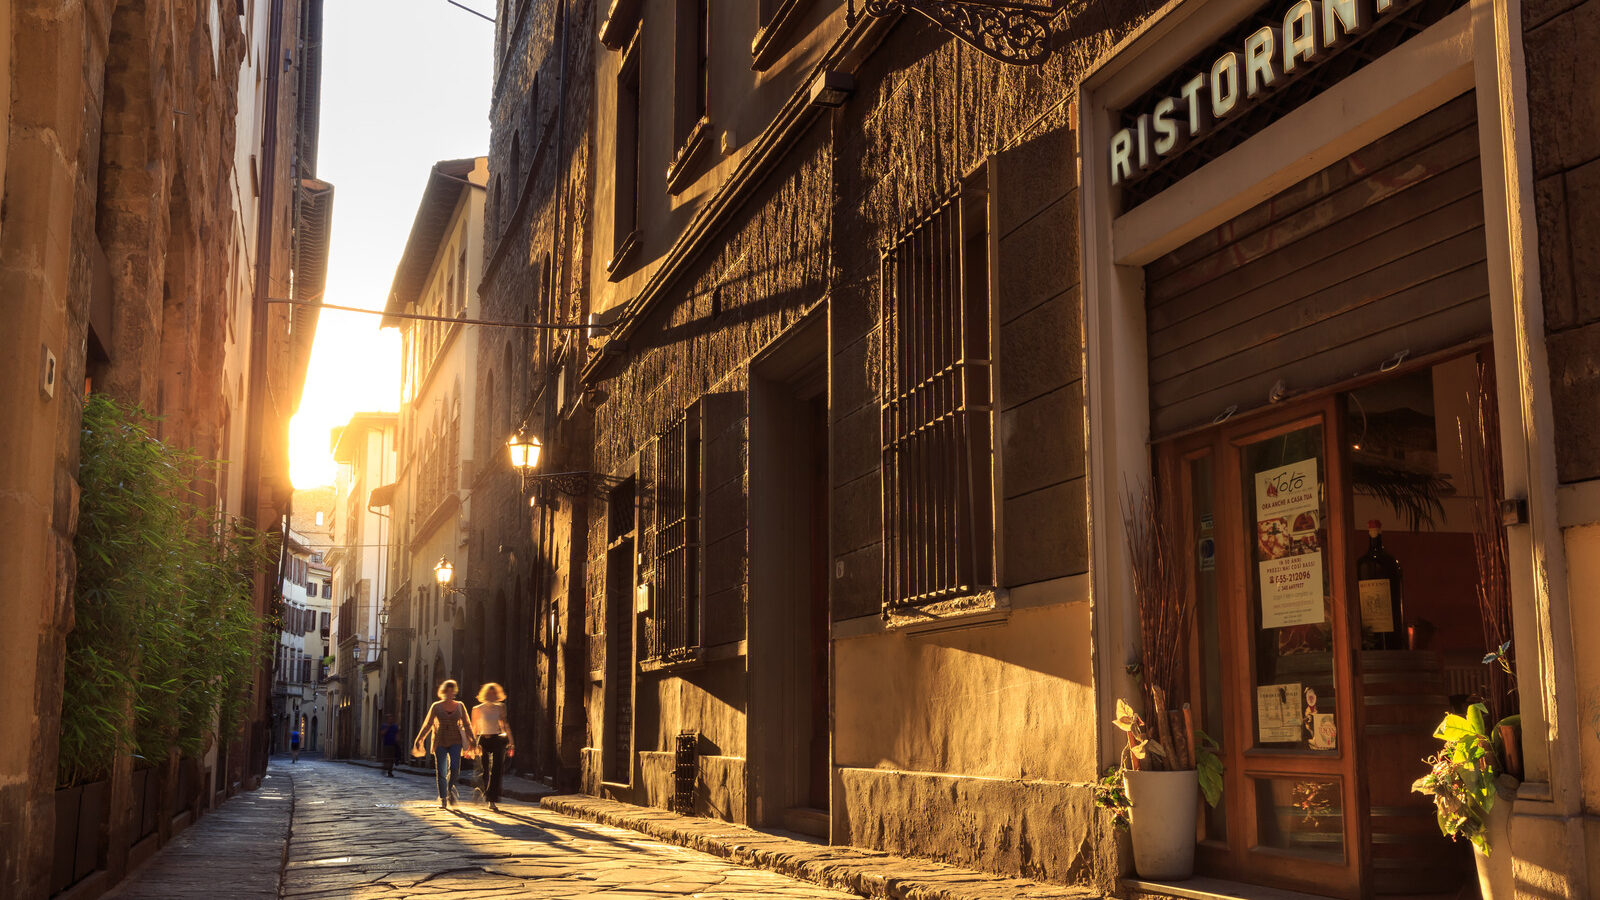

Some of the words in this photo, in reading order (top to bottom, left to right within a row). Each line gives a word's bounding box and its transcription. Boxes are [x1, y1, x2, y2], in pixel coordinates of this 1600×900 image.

[1110, 0, 1393, 186] RISTORAN
[1261, 502, 1271, 510] ORA
[1272, 499, 1286, 507] ANCHE
